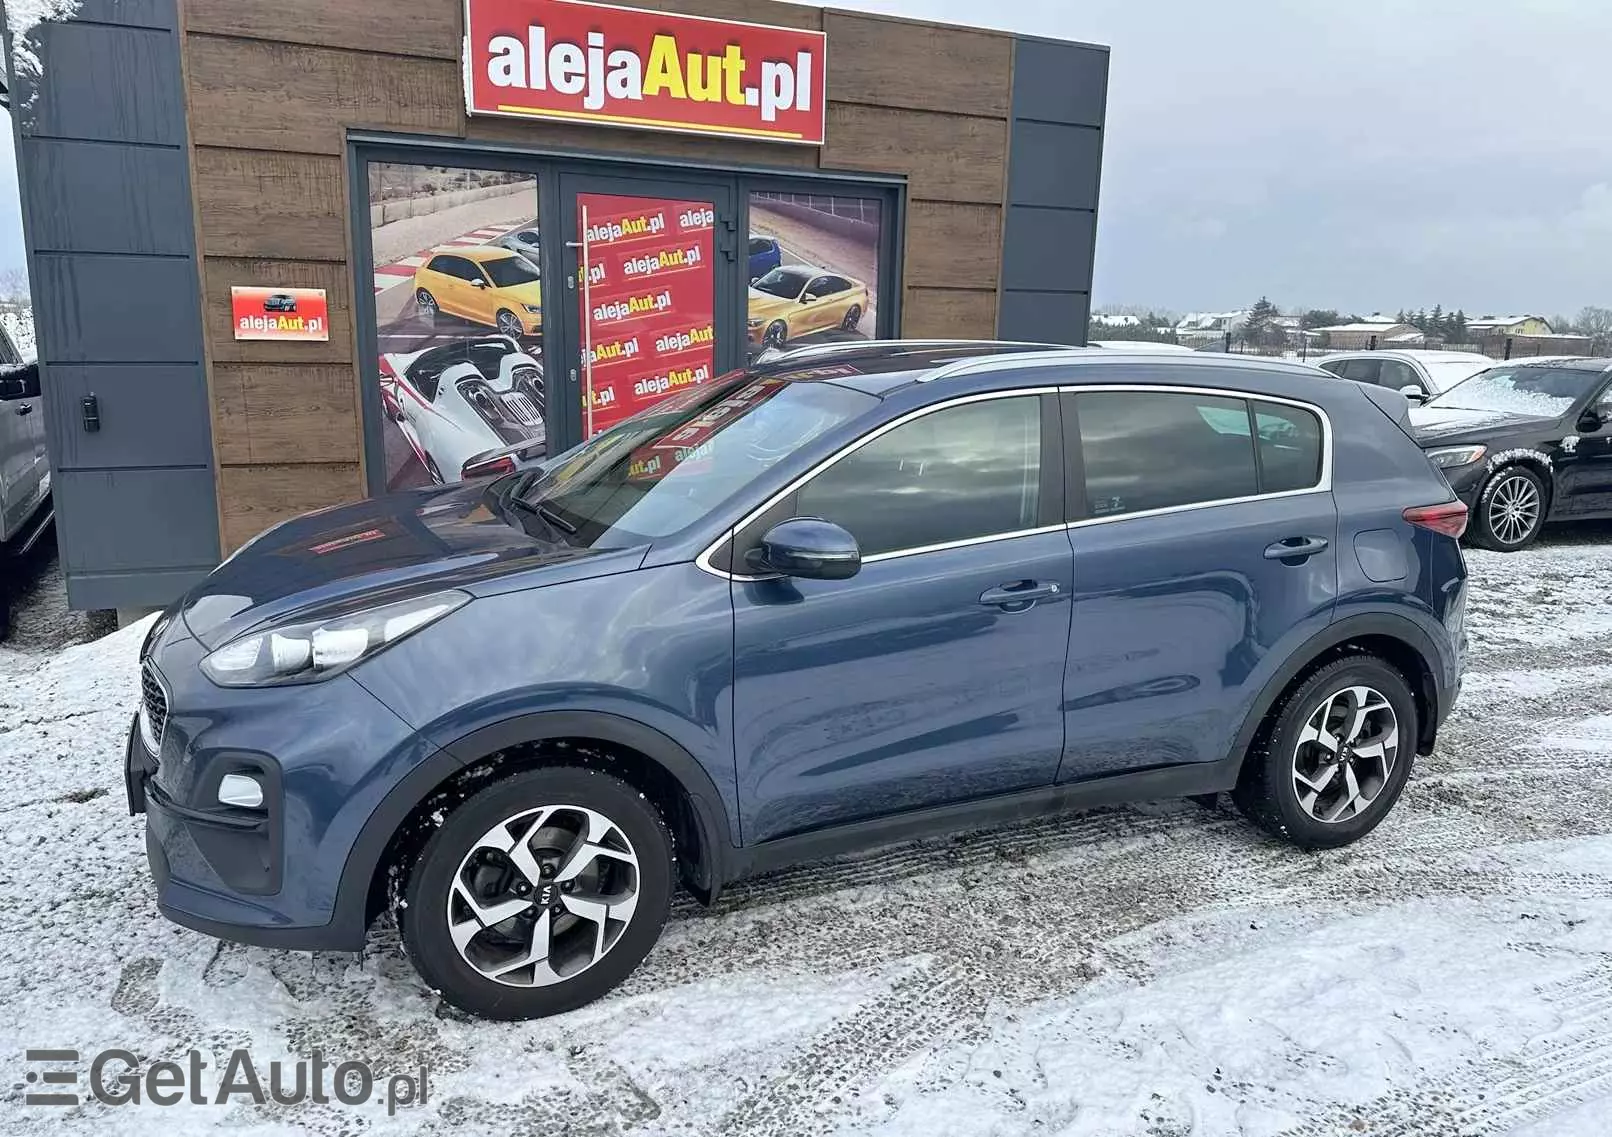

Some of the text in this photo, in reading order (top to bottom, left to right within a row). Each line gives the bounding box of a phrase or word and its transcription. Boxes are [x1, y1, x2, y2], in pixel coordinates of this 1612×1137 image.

[487, 24, 813, 122] alejaAut.pl
[623, 245, 702, 276] alejaAut.pl
[592, 290, 672, 321] alejaAut.pl
[239, 315, 323, 333] alejaAut.pl
[655, 324, 714, 353] alejaAut
[634, 364, 709, 397] alejaAut.pl
